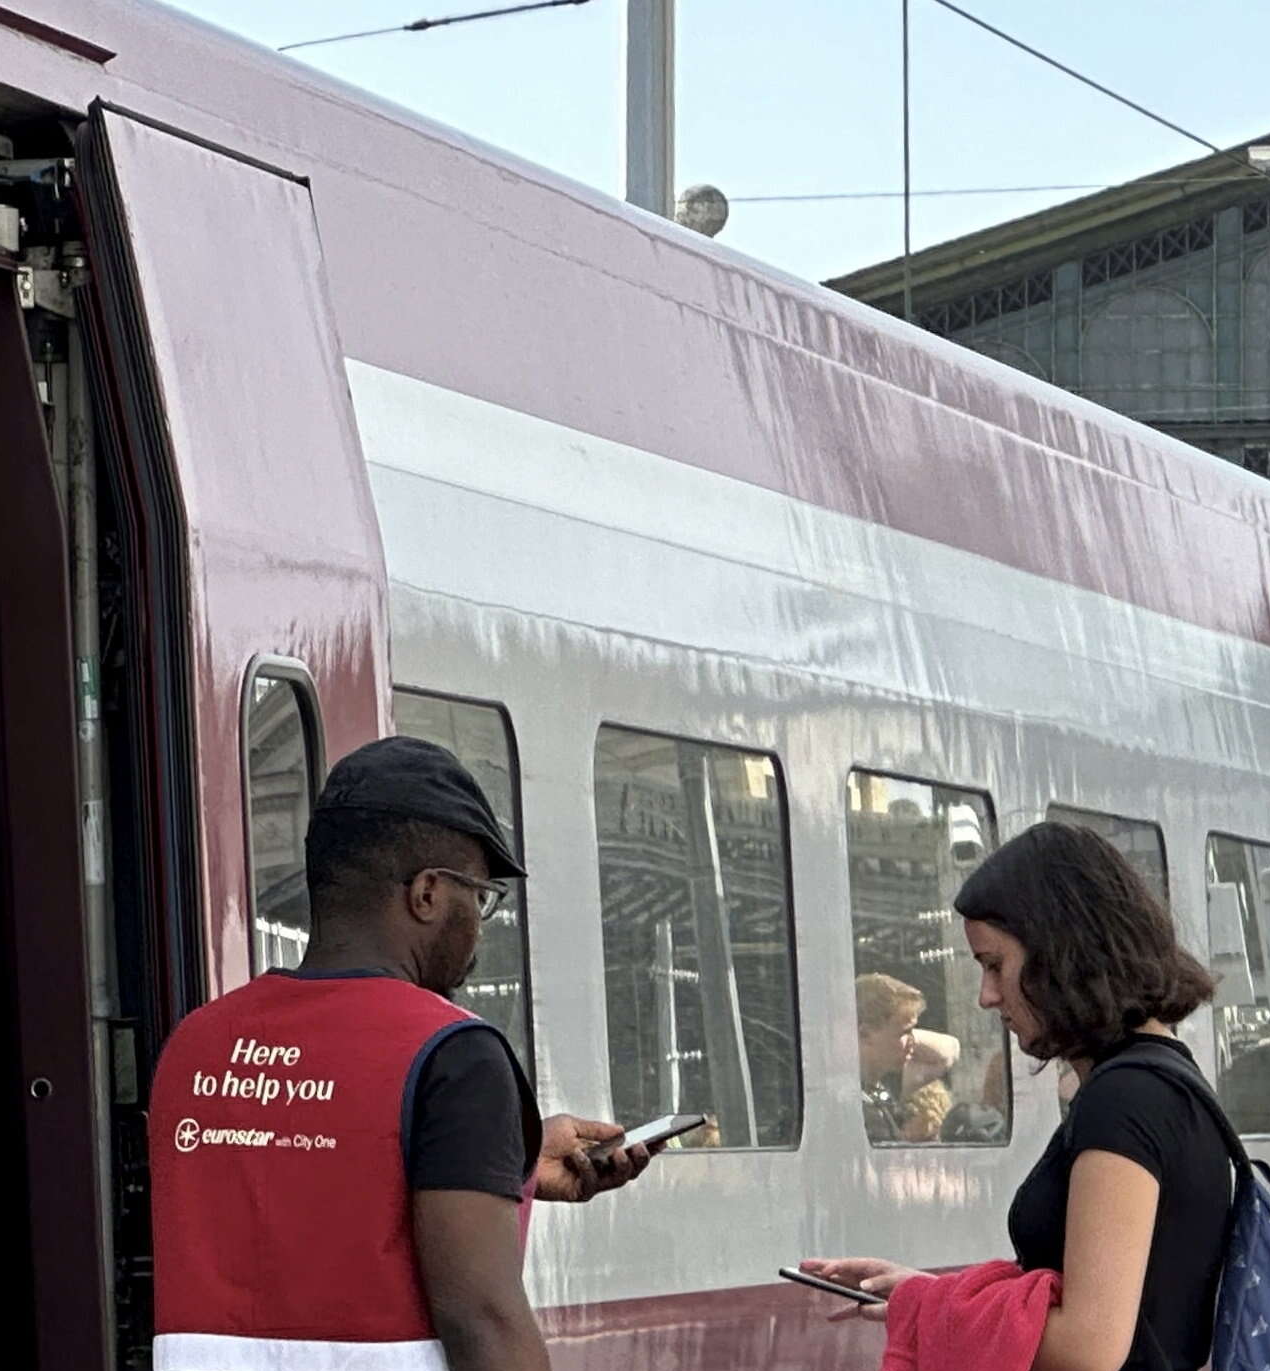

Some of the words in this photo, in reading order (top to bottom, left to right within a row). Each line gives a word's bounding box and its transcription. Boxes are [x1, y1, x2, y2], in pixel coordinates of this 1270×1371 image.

[230, 1038, 301, 1066] Here
[193, 1070, 217, 1097] to
[221, 1071, 280, 1105] help
[286, 1079, 335, 1106] you
[202, 1127, 275, 1146] eurostar
[293, 1134, 313, 1151] City
[314, 1134, 336, 1149] One
